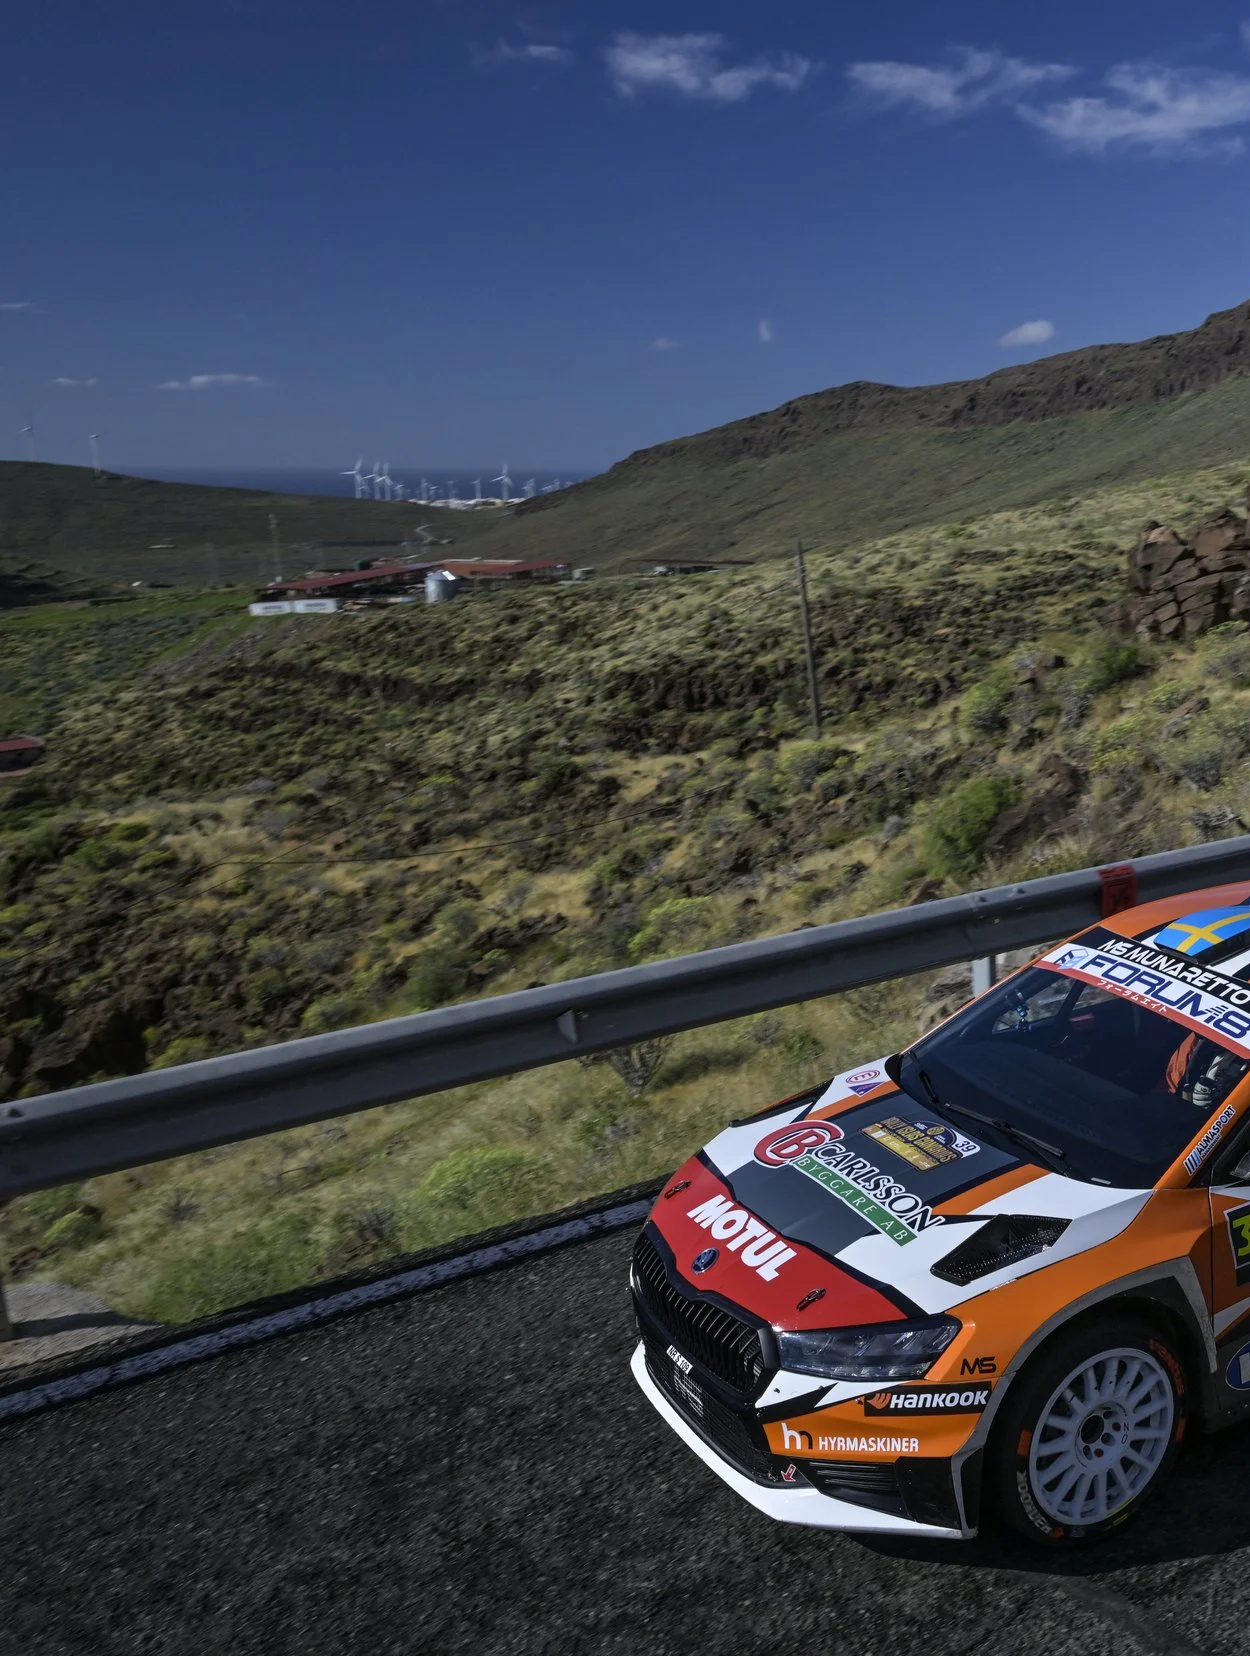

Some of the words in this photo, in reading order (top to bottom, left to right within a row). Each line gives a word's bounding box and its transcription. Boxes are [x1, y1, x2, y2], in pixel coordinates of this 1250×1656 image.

[1097, 979, 1168, 1013] フォーラムエイト
[956, 1140, 977, 1152] 39
[1196, 1105, 1236, 1157] ALMASPORT
[798, 1157, 877, 1215] BYGGARE
[881, 1220, 908, 1241] AB
[813, 1143, 945, 1232] CARLSSON
[686, 1194, 798, 1282] MOTUL
[960, 1356, 997, 1375] MS
[818, 1436, 919, 1453] HYRMASKINER
